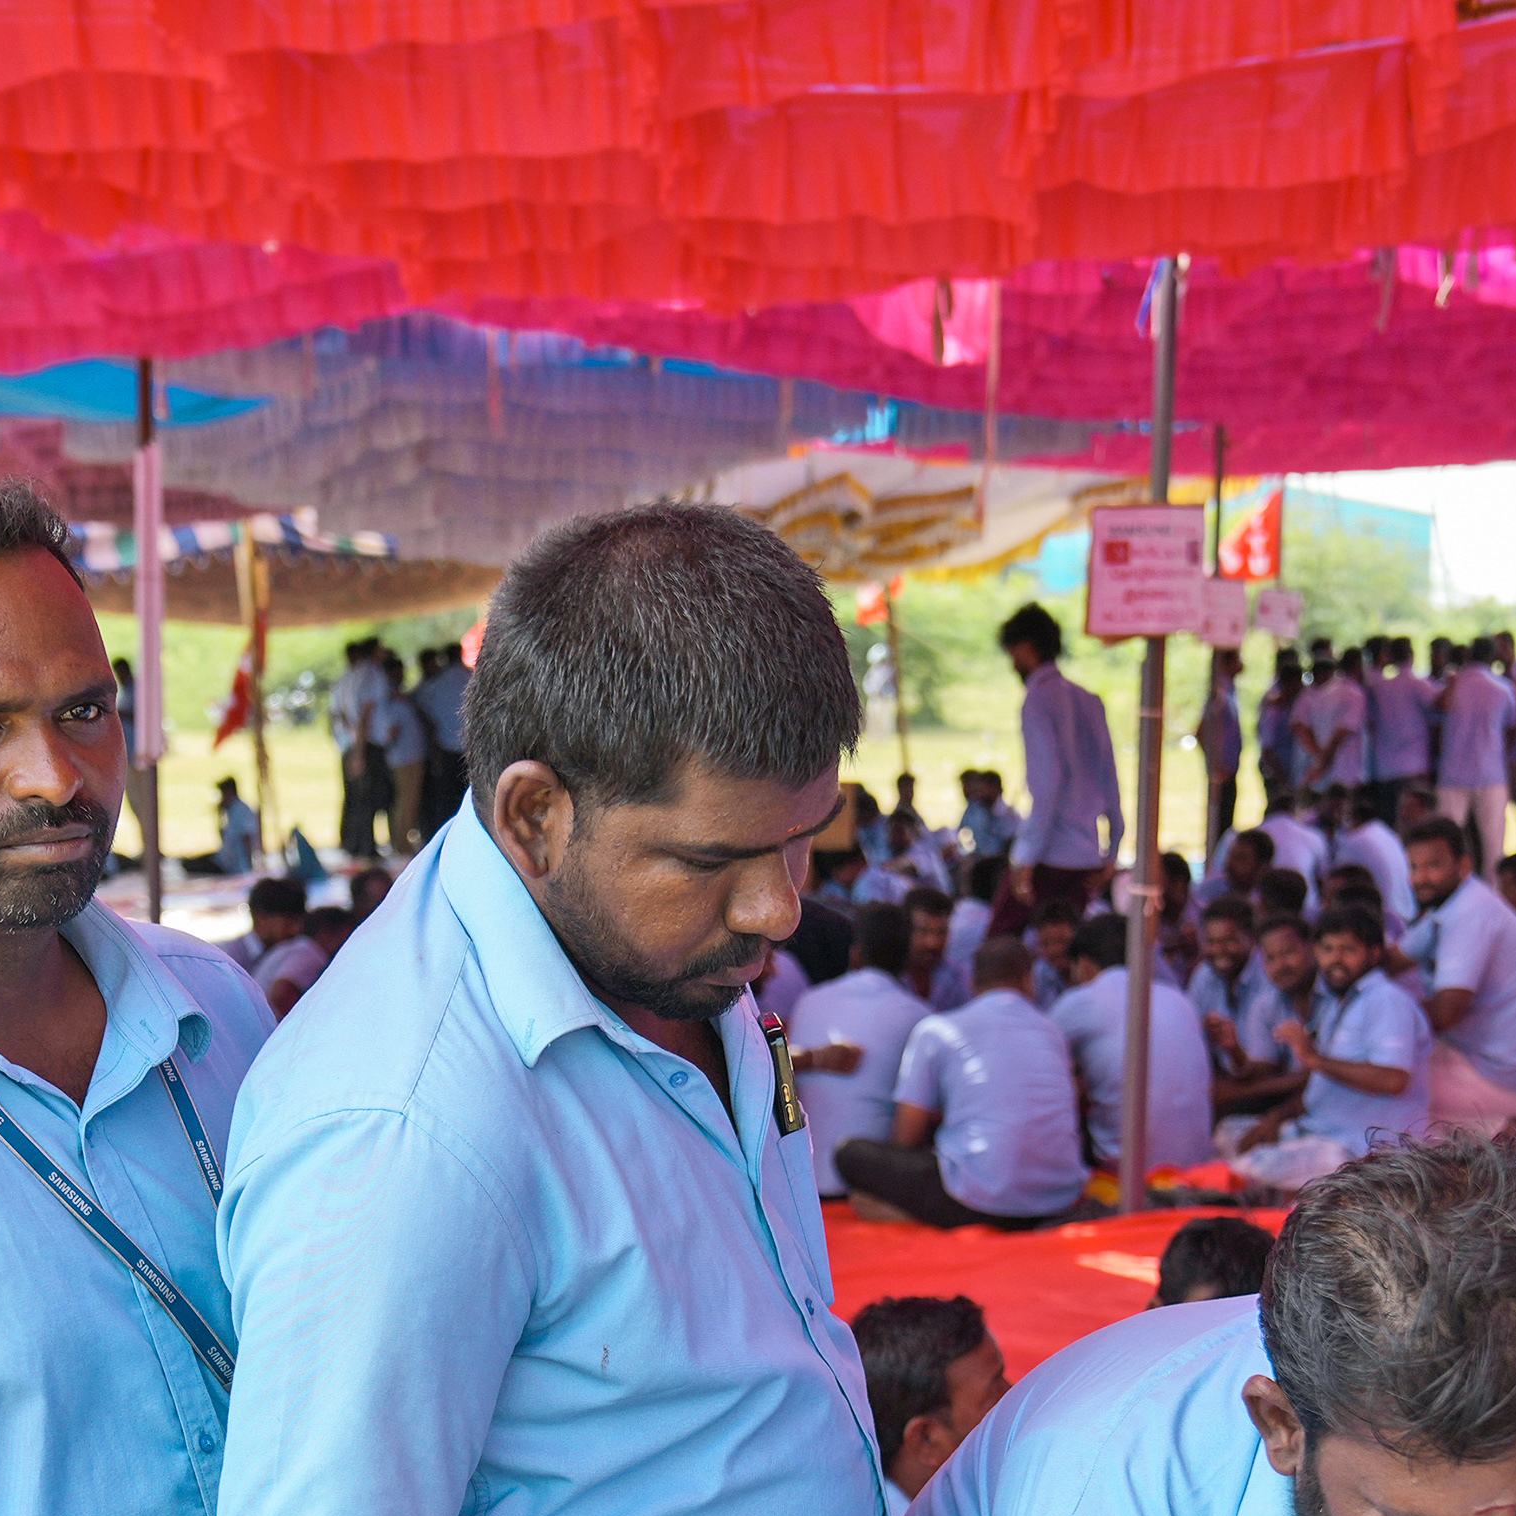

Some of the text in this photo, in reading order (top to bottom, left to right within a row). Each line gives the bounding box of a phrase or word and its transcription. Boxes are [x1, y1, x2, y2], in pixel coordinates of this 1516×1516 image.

[195, 1139, 222, 1191] SAMSUNG
[47, 1171, 94, 1217] SAMSUNG
[136, 1258, 178, 1304] SAMSUNG
